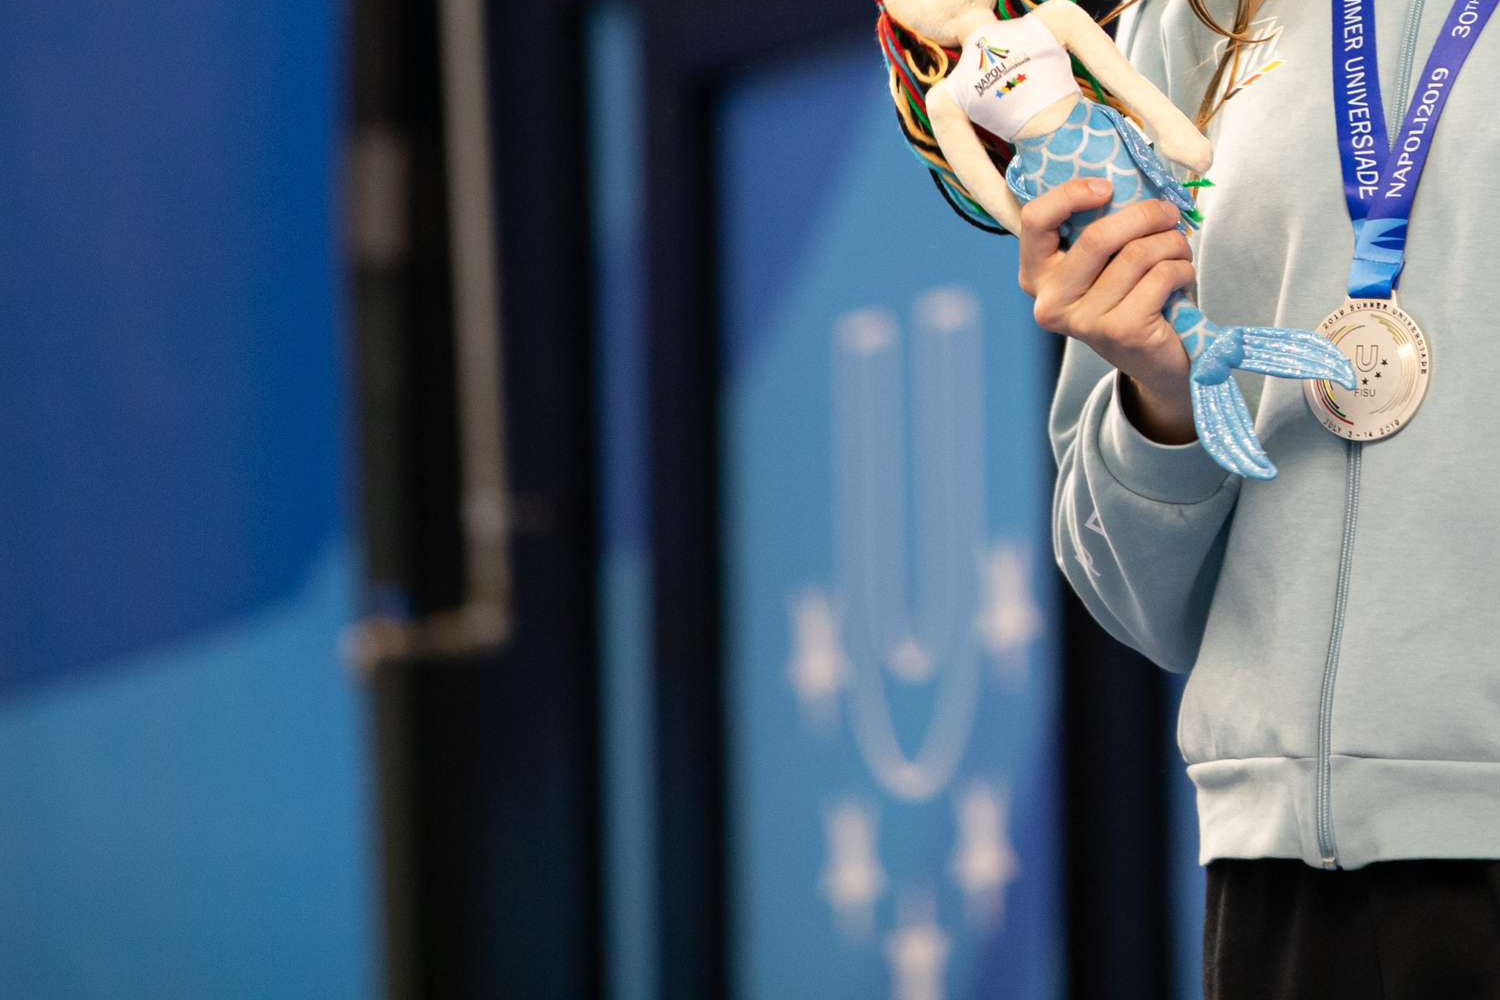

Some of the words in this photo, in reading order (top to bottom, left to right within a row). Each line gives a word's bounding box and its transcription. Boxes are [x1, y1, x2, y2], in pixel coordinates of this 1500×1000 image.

[1344, 56, 1380, 200] UNIVERSIADE
[1385, 67, 1449, 199] NAPOLI2019
[1322, 310, 1345, 329] 2019
[1349, 302, 1388, 311] SUMMER
[1392, 308, 1427, 375] UNIVERSIADE
[1323, 419, 1342, 433] JULY
[1354, 388, 1376, 398] FISU
